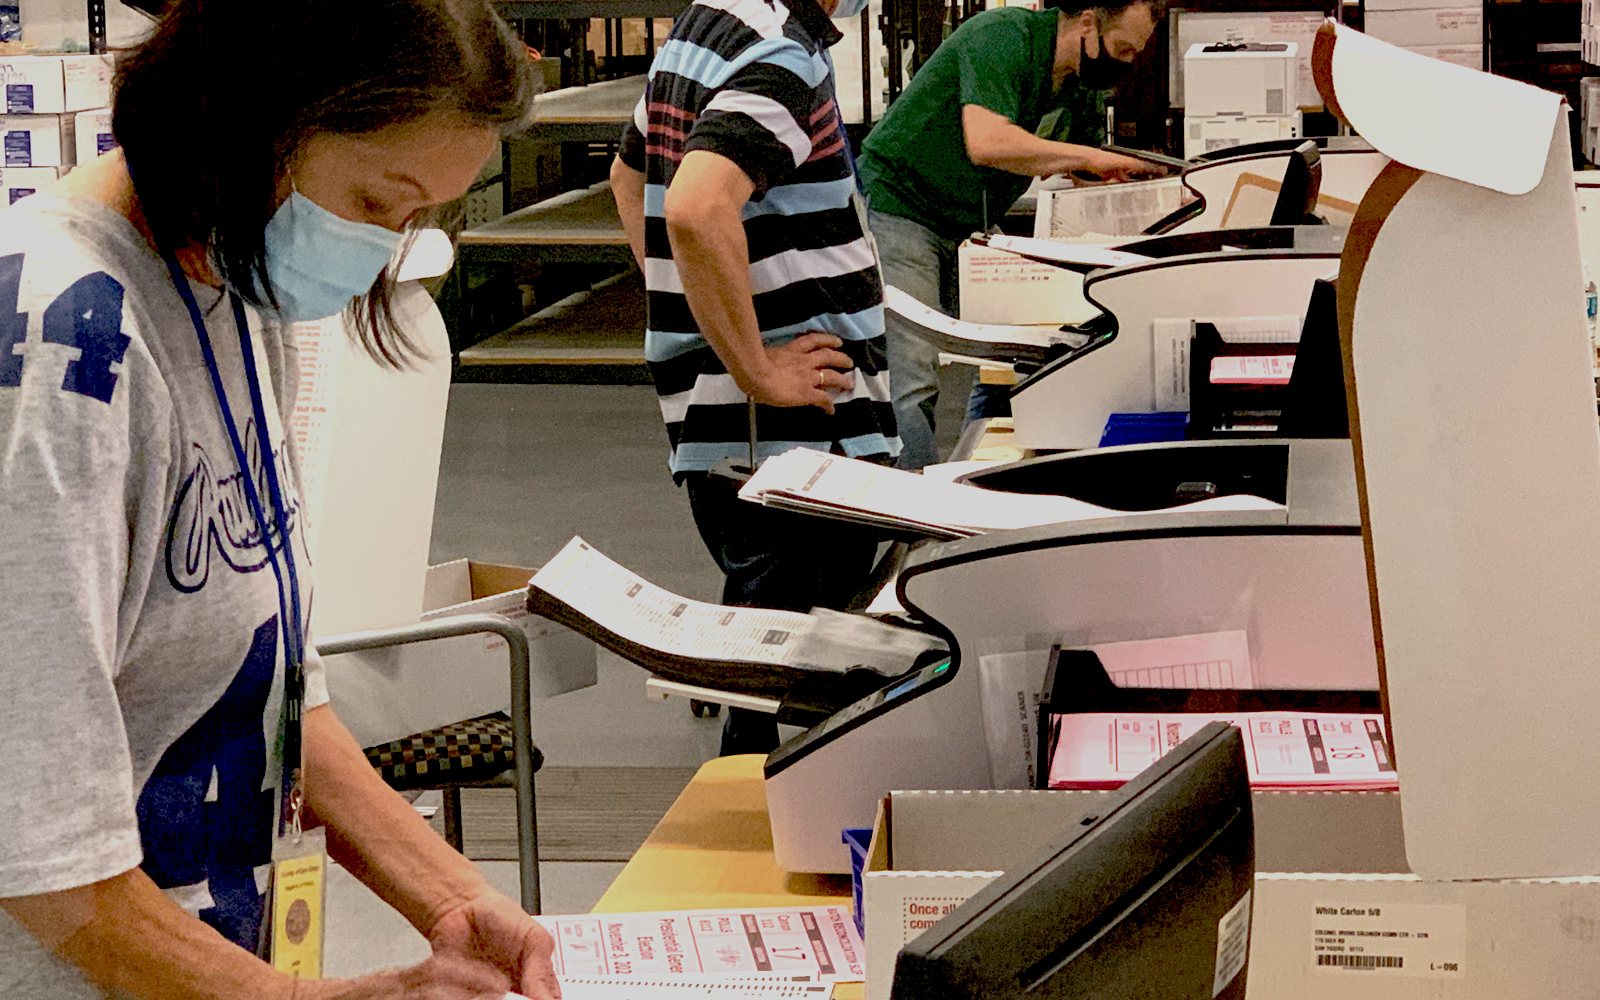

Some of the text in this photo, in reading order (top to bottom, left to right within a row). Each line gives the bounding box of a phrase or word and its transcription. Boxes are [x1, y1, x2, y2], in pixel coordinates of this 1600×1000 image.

[1330, 746, 1366, 760] 18
[909, 902, 939, 915] Once
[1316, 906, 1338, 916] White
[1340, 907, 1366, 917] Carton
[717, 917, 733, 933] POLLS
[777, 915, 792, 931] Canon
[607, 923, 627, 952] November
[658, 918, 680, 953] Presidential
[636, 936, 655, 960] Election
[771, 946, 806, 960] 17
[849, 963, 864, 975] SLIP
